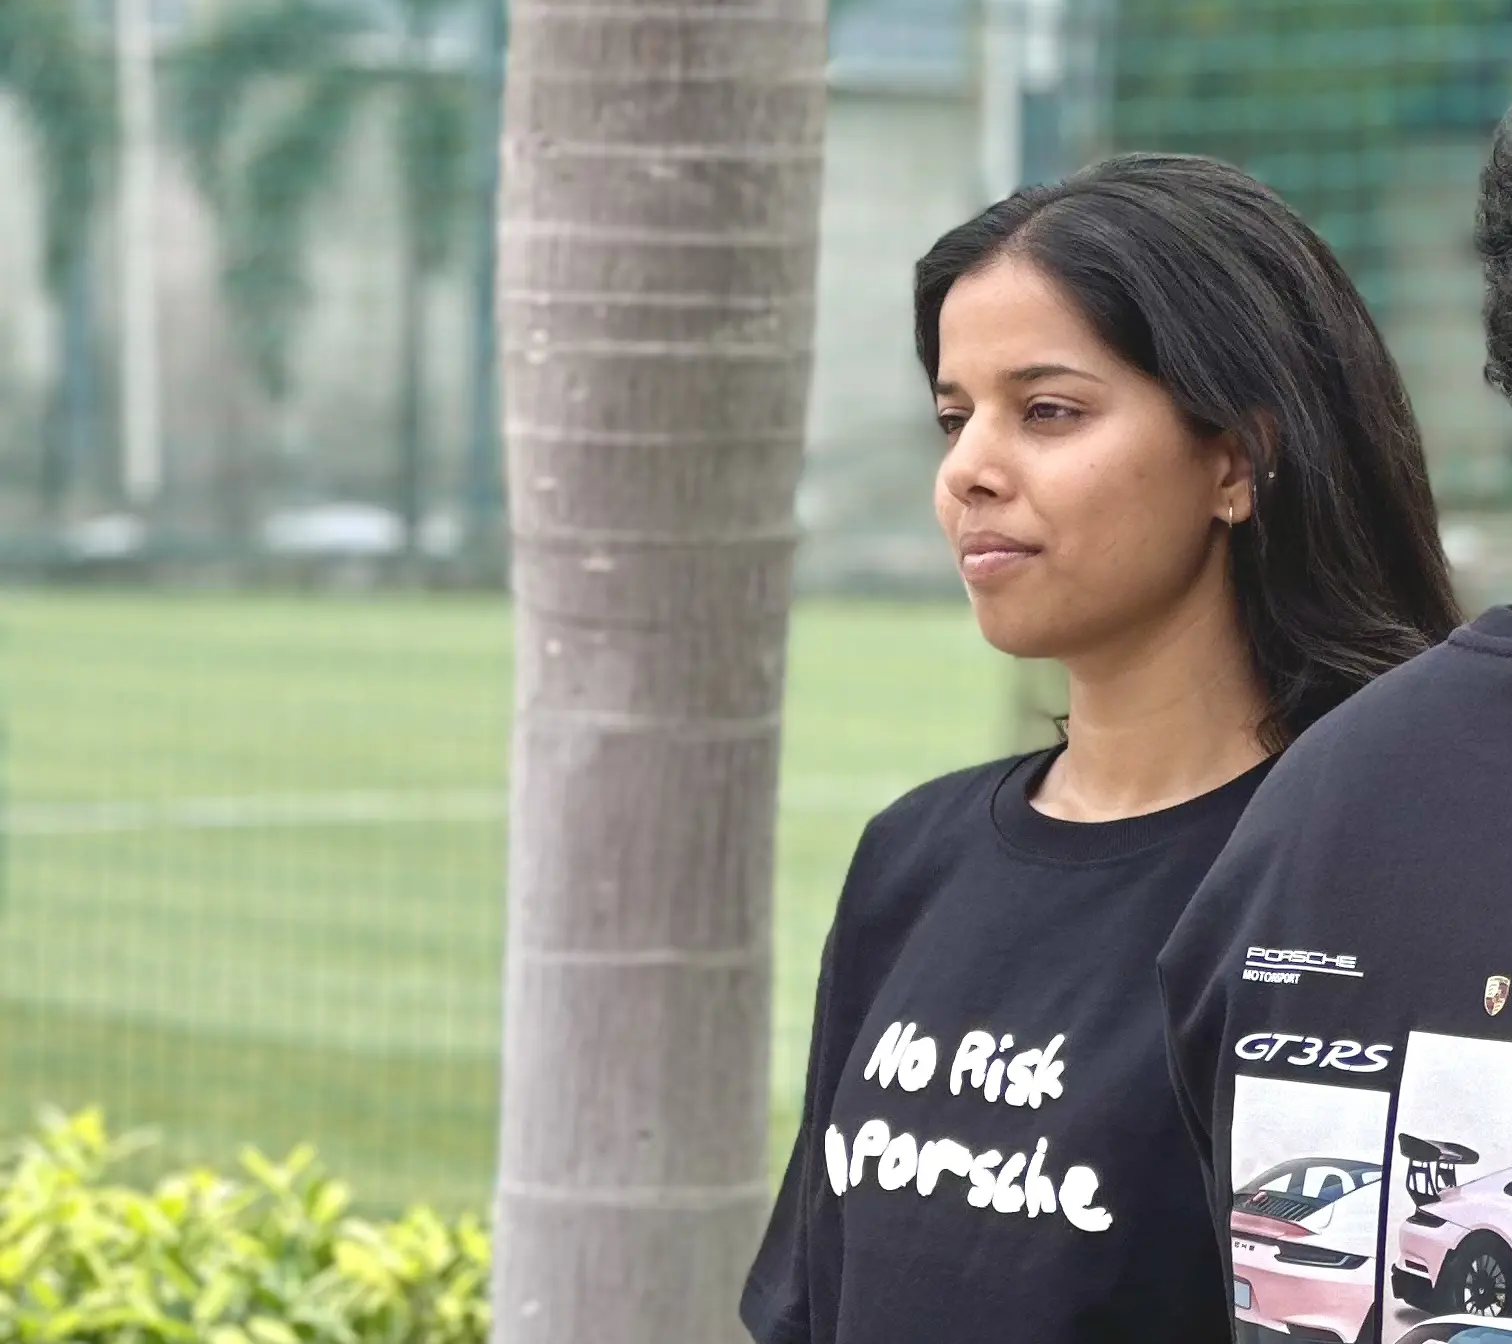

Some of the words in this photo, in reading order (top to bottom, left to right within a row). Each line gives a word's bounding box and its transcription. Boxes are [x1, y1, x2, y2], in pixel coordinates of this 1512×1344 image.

[1242, 968, 1301, 985] MOTORSPORT
[1246, 946, 1357, 969] PORSCHE
[863, 1021, 938, 1092] No
[949, 1029, 1066, 1110] Risk
[1234, 1032, 1394, 1073] GT3RS
[848, 1119, 1113, 1232] Porsche
